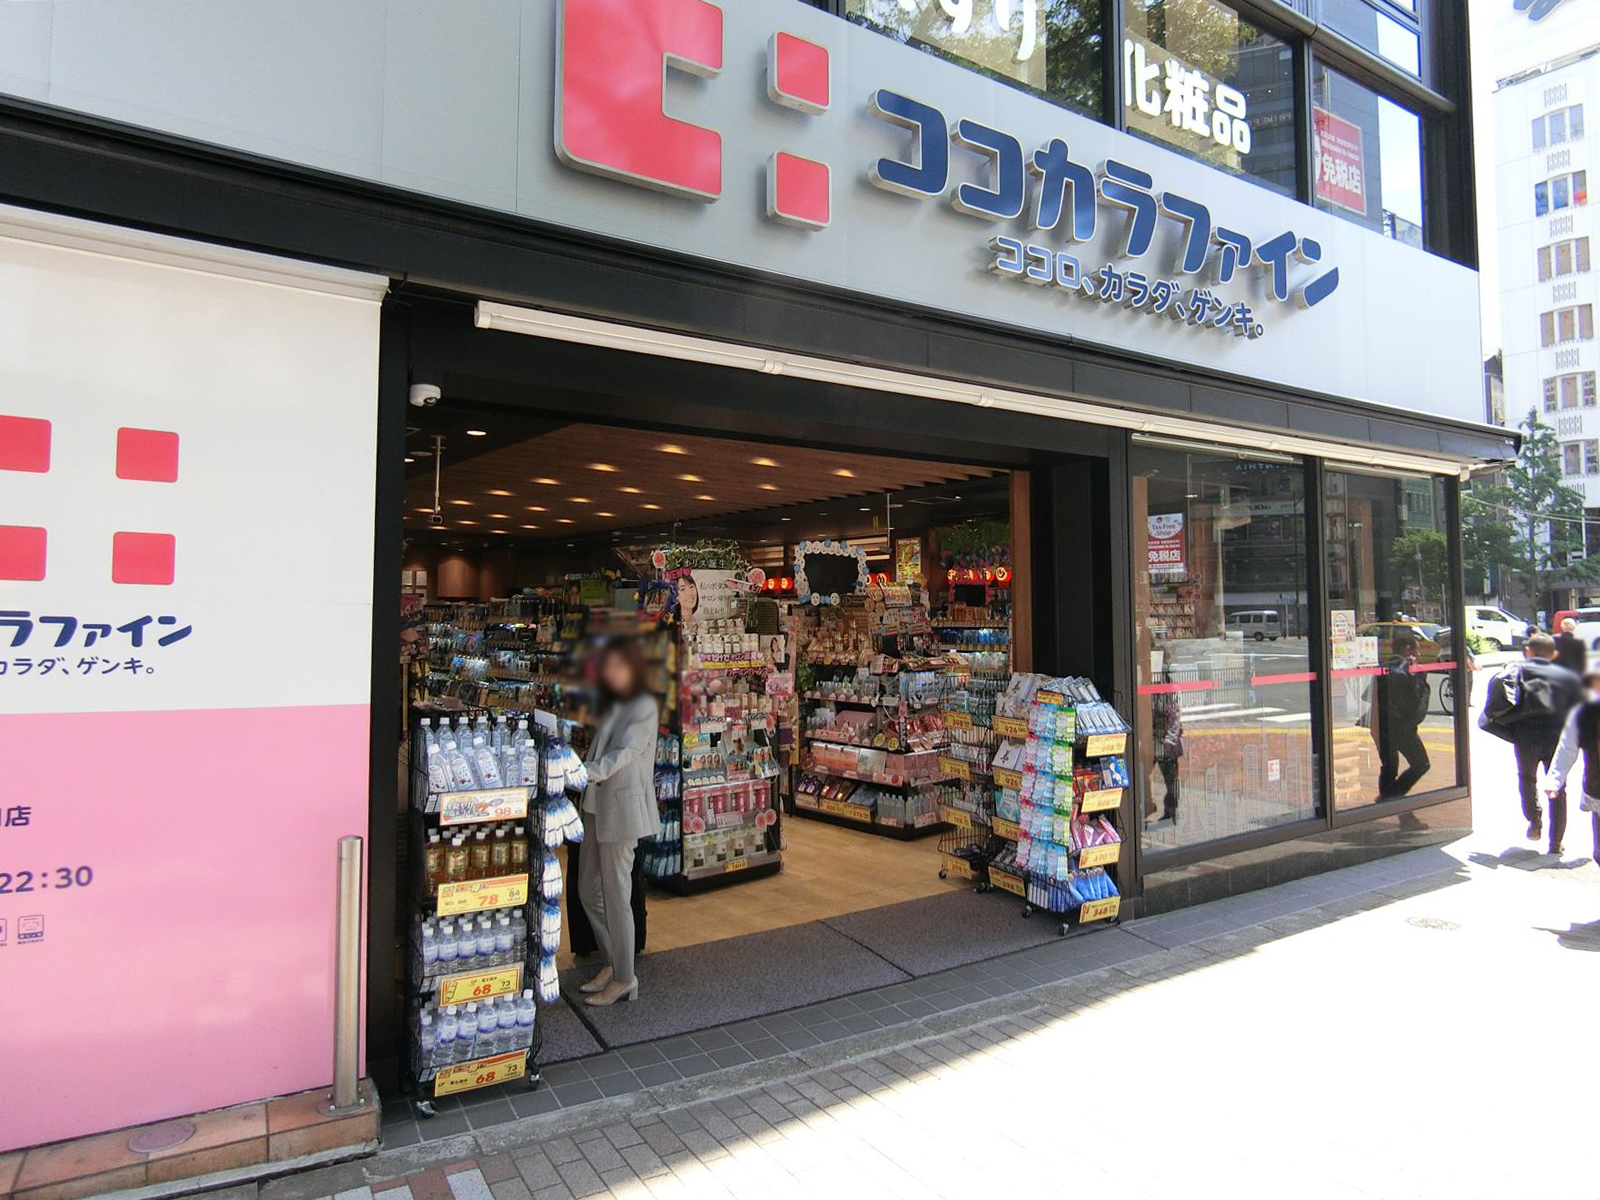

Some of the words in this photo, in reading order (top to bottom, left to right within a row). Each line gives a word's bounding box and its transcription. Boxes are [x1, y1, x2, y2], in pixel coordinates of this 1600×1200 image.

[1124, 39, 1252, 154] 化粧品
[872, 88, 1340, 308] ココカラファイン
[995, 235, 1264, 338] ココロ、カラダ、ゲンキ。
[0, 806, 32, 827] 店
[494, 807, 512, 816] 98
[477, 894, 499, 906] 78
[509, 889, 521, 898] 84
[472, 984, 492, 996] 68
[476, 1071, 496, 1084] 68
[506, 1065, 518, 1073] 73
